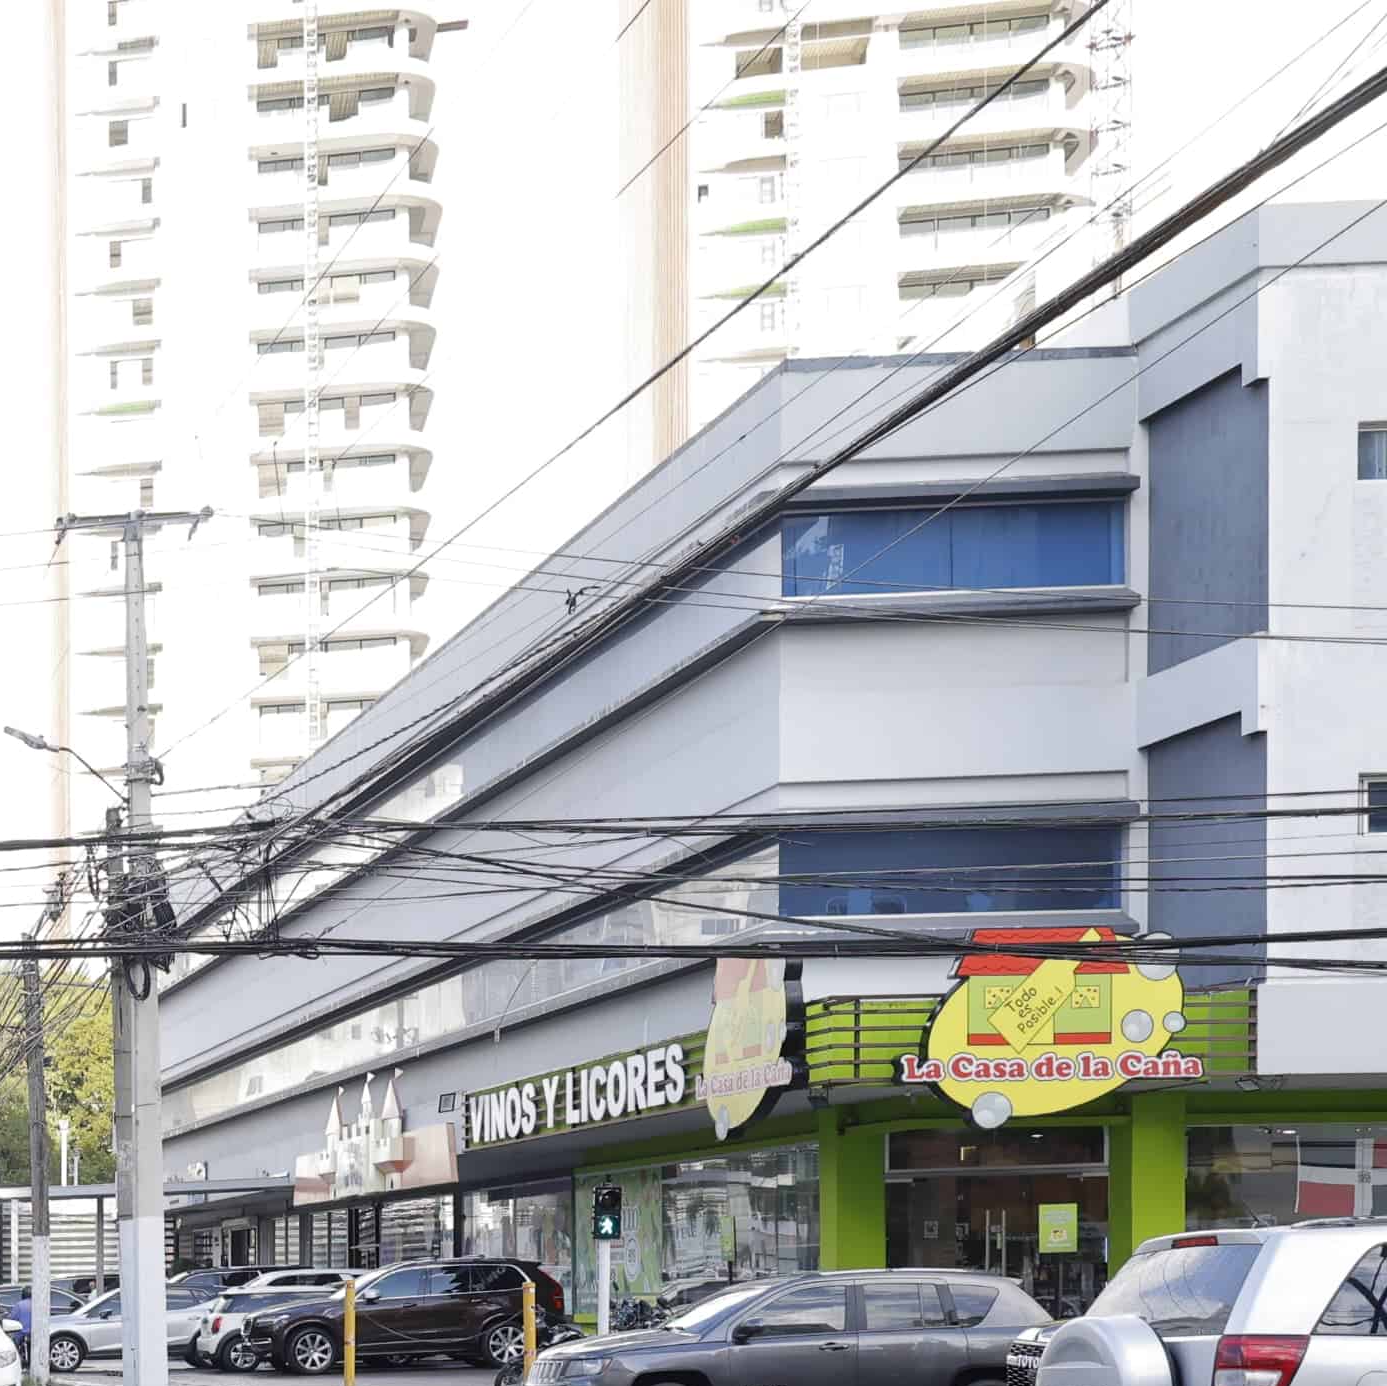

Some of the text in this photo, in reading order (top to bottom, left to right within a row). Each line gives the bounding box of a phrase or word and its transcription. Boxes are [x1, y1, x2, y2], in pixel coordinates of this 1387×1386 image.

[1004, 987, 1037, 1012] Todo
[1019, 1004, 1032, 1018] es
[904, 1053, 1201, 1080] La Casa de la Caña
[469, 1044, 686, 1143] VINOS Y LICORES
